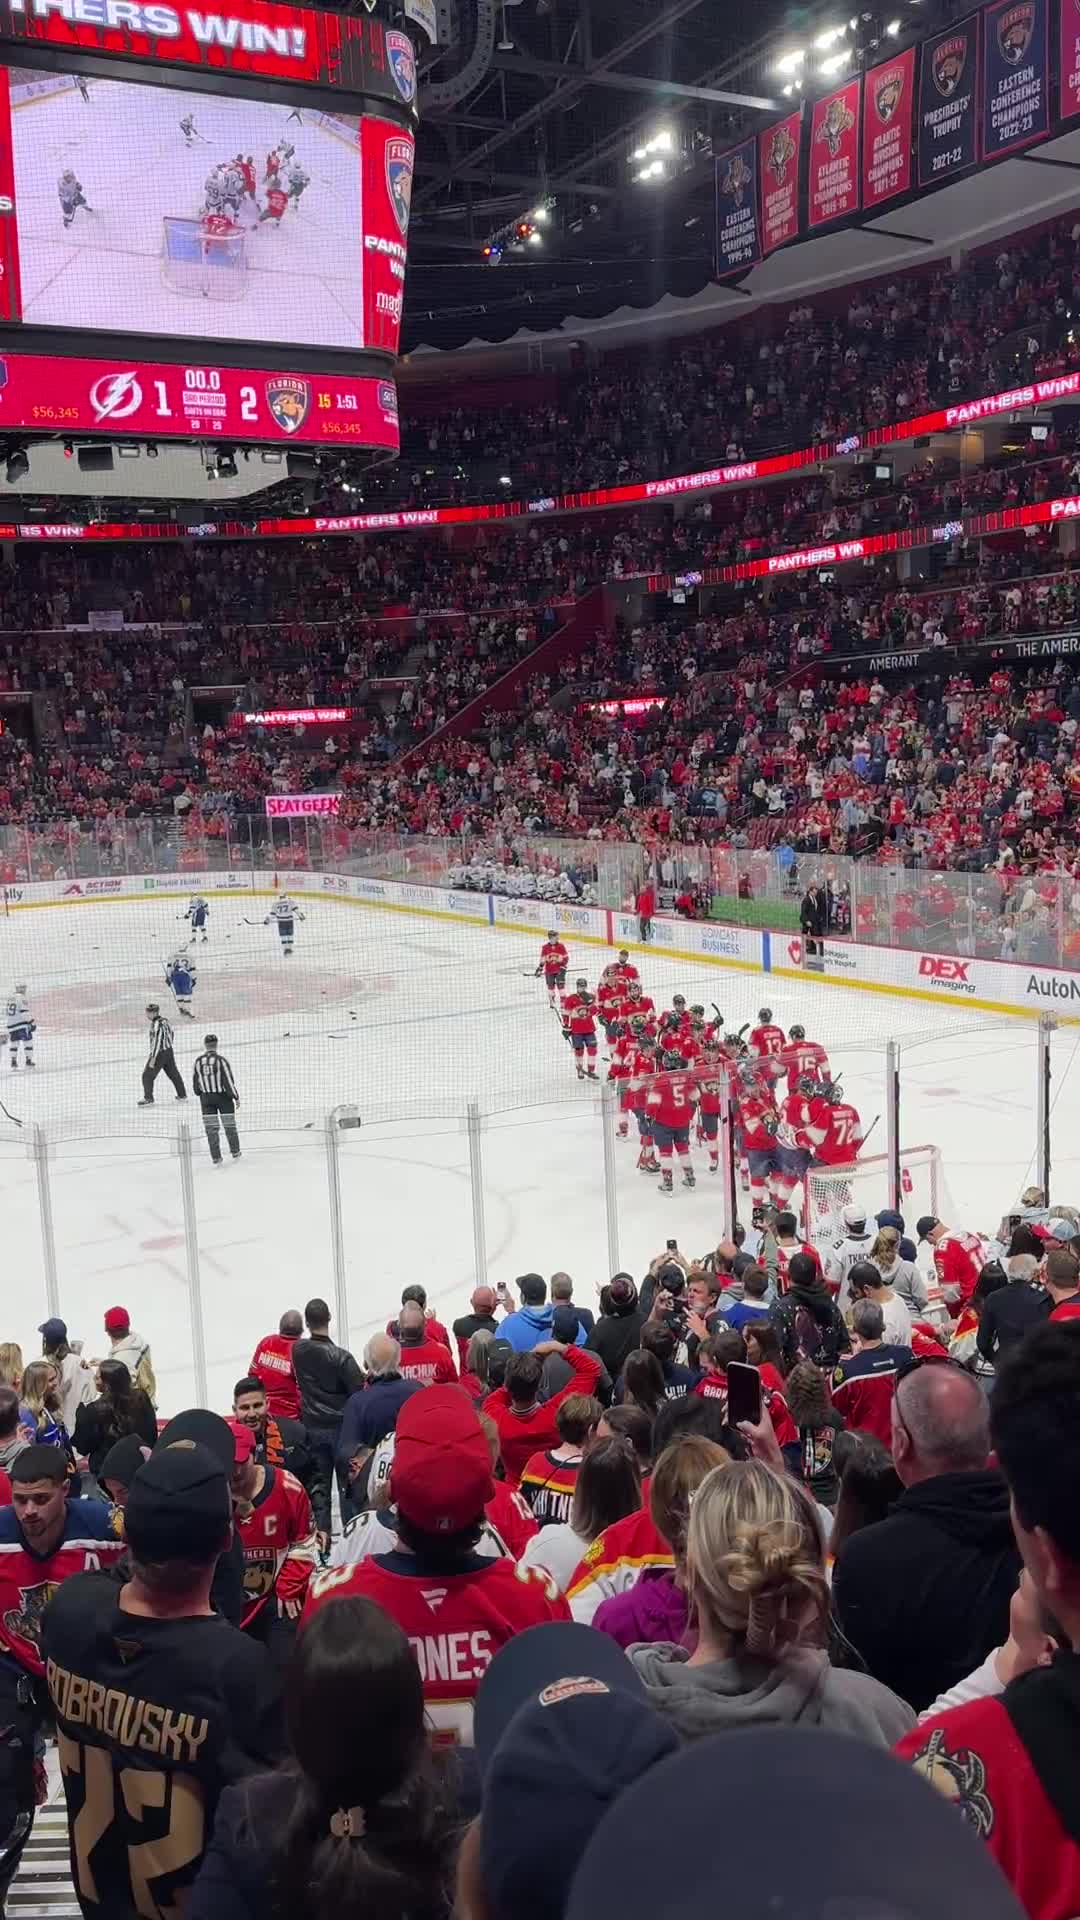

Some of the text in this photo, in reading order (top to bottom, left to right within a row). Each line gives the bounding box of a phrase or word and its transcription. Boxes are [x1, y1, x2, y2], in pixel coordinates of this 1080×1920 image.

[187, 9, 306, 57] WIN!
[998, 65, 1034, 93] EASTERN
[991, 79, 1041, 112] CONFERENCE
[992, 96, 1040, 128] CHAMPIONS
[933, 115, 962, 139] TROPHY
[185, 370, 220, 390] 00.0
[154, 380, 172, 416] 1
[240, 387, 258, 421] 2
[317, 393, 358, 409] 15 1:51
[946, 375, 1079, 425] PANTHERS WIN!
[32, 405, 80, 419] $56,345
[321, 422, 361, 434] $56,345
[646, 464, 756, 495] PANTHERS WIN!
[314, 510, 439, 530] PANTHERS WIN!
[42, 526, 84, 537] WIN!
[768, 547, 837, 570] PANTHERS
[1016, 642, 1038, 657] THE
[869, 654, 920, 671] AMERANT
[267, 798, 339, 814] SEATGEEK
[701, 939, 740, 954] BUSINESS
[919, 956, 970, 982] DEX
[930, 977, 976, 993] imaging
[672, 1085, 686, 1107] 5
[400, 1363, 437, 1379] KACHUK
[264, 1515, 278, 1537] C
[407, 1630, 493, 1682] ONES
[47, 1655, 209, 1761] BOBROVSKY
